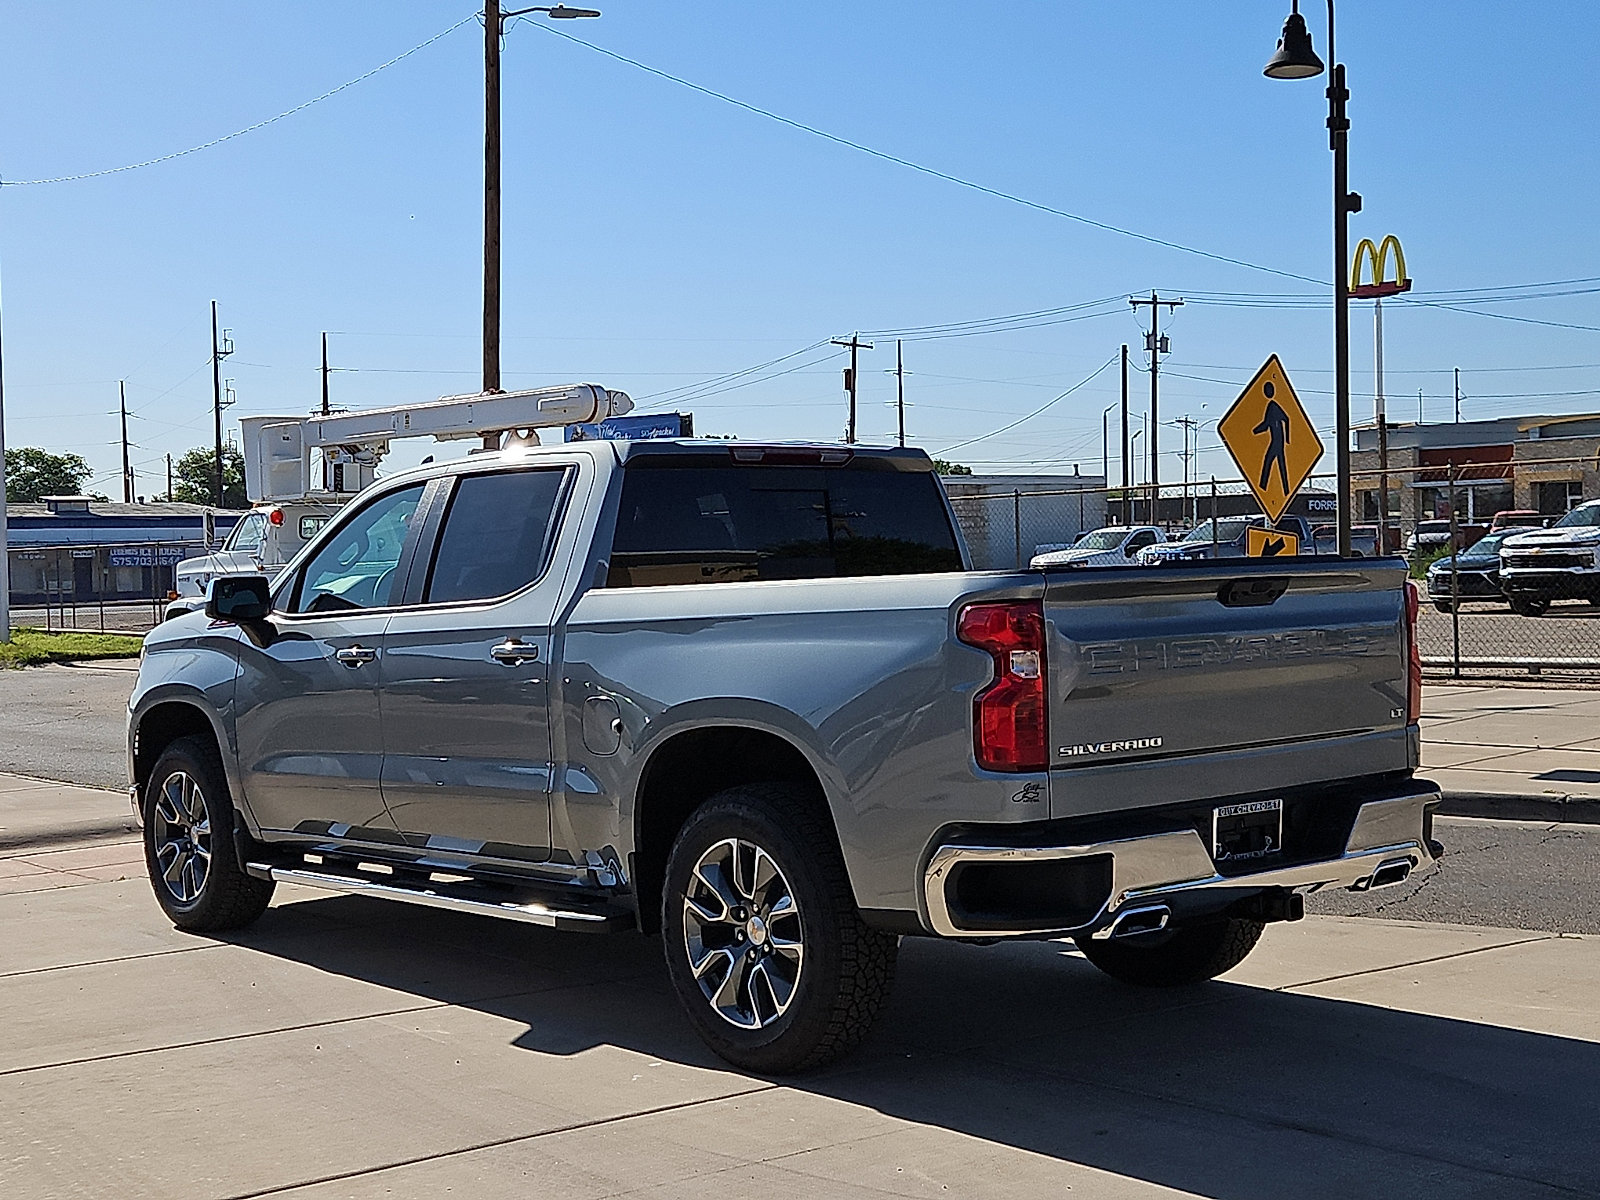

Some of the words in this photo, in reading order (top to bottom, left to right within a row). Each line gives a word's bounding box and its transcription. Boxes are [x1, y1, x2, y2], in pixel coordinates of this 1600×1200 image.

[1391, 708, 1404, 718] LT
[1058, 736, 1163, 757] SILVERADO
[1237, 800, 1280, 814] CHEVROLET
